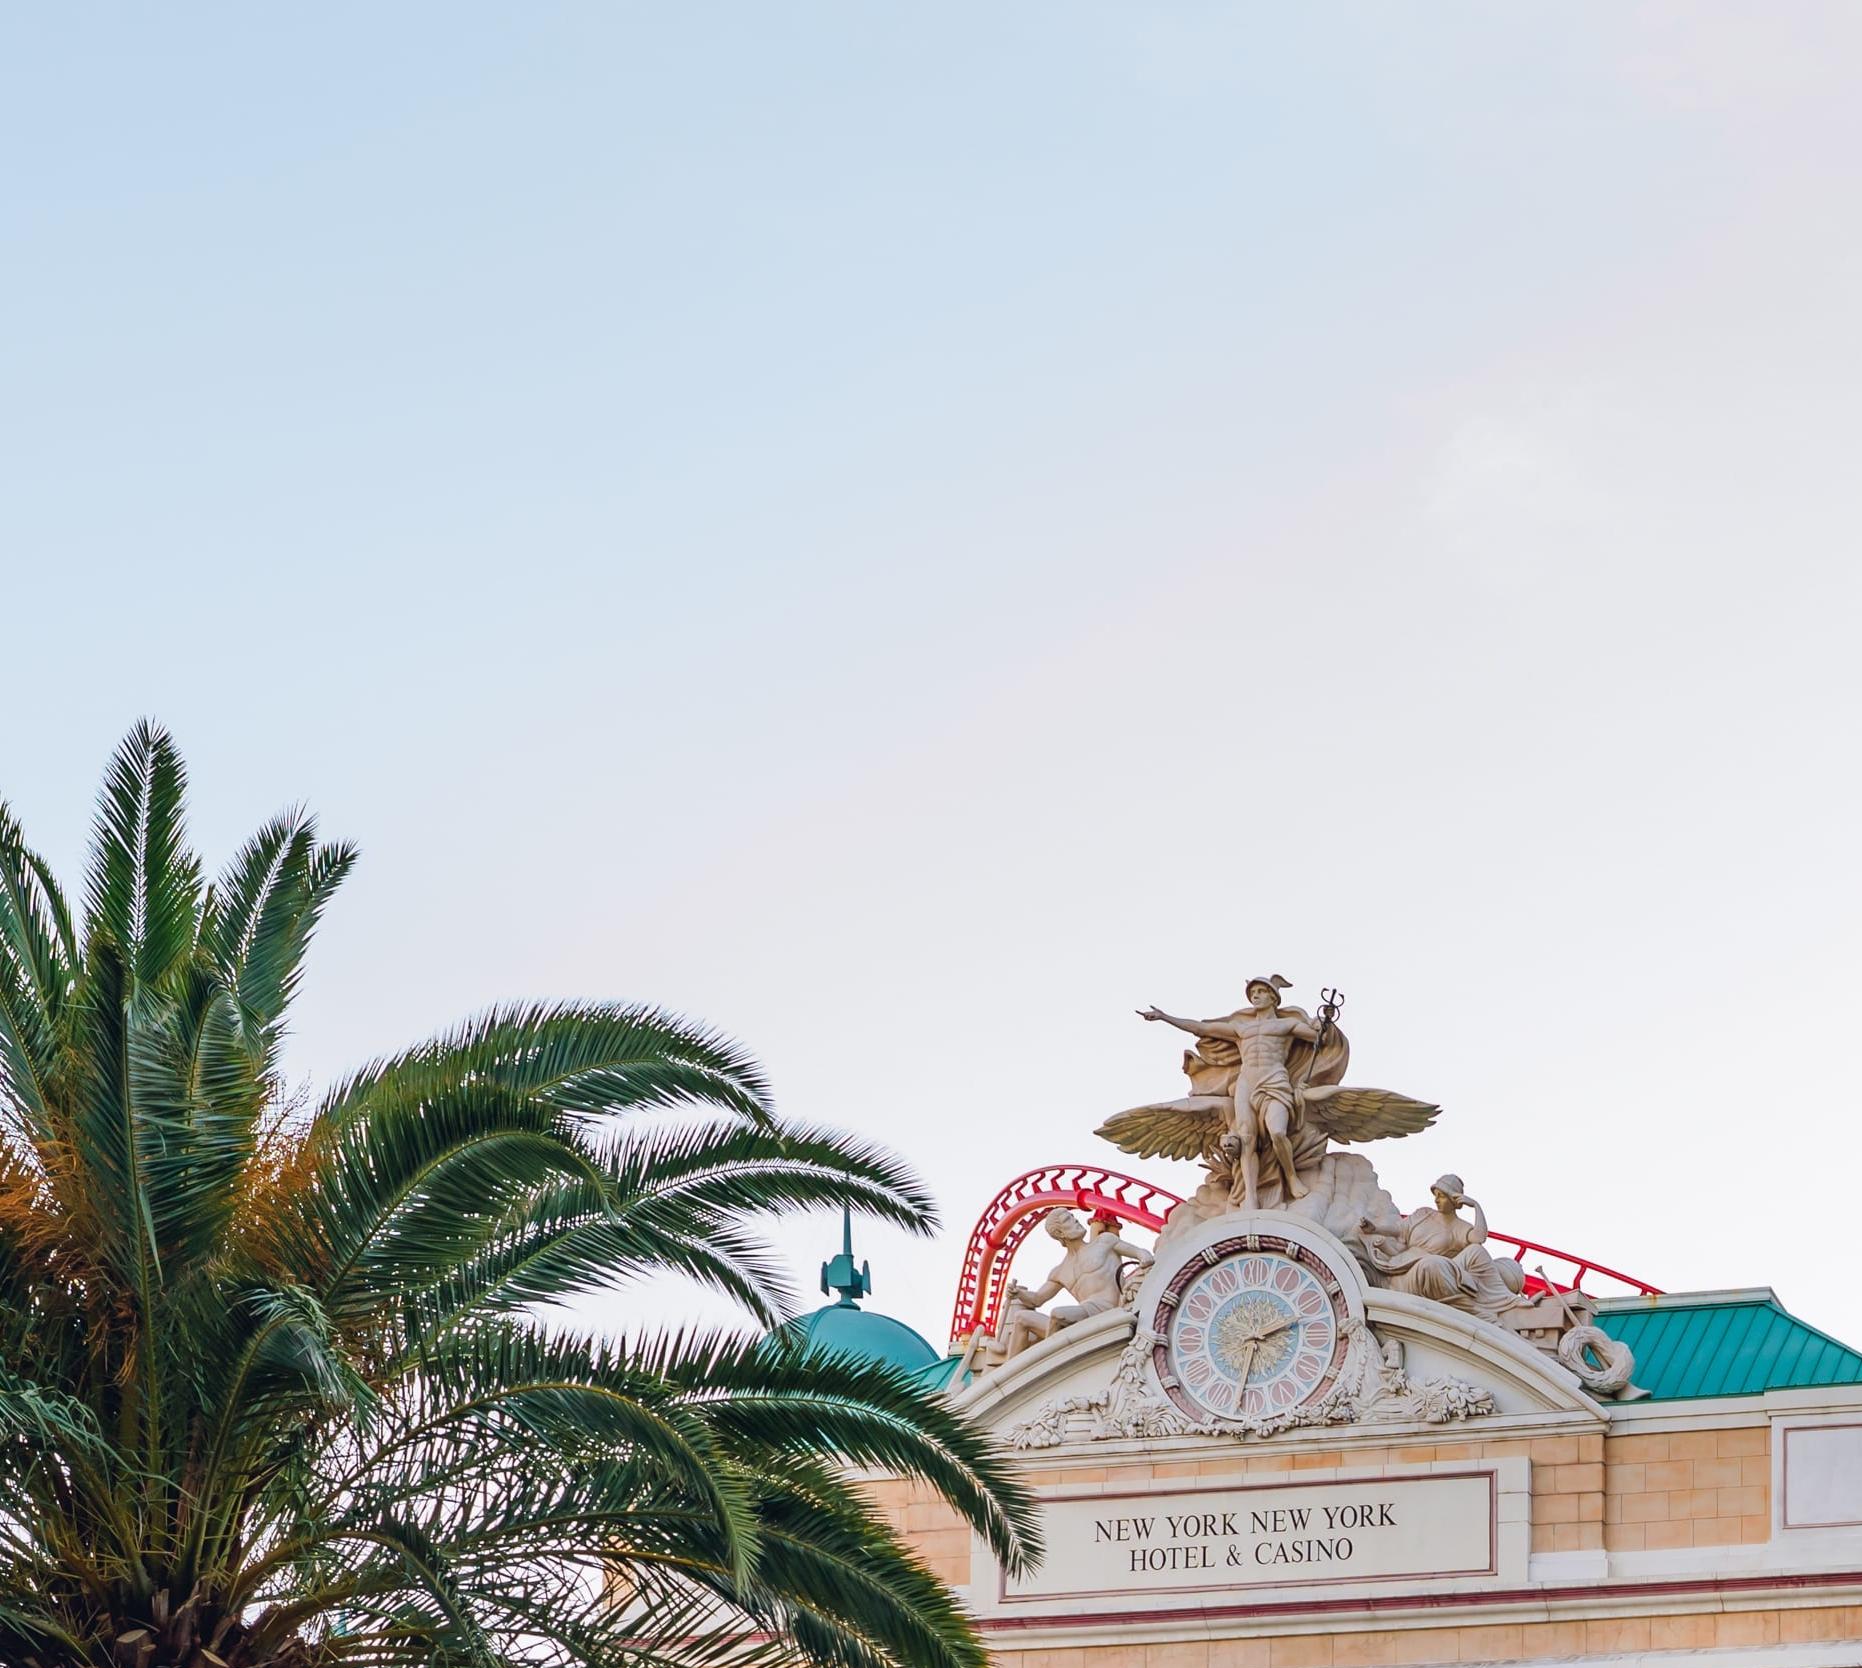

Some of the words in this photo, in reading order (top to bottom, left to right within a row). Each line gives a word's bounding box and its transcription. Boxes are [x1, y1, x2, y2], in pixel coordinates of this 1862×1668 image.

[1095, 1517, 1155, 1543] NEW
[1166, 1512, 1239, 1538] YORK
[1250, 1508, 1312, 1533] NEW
[1322, 1503, 1397, 1530] YORK
[1130, 1545, 1215, 1572] HOTEL
[1226, 1544, 1242, 1566] &
[1255, 1537, 1353, 1564] CASINO
